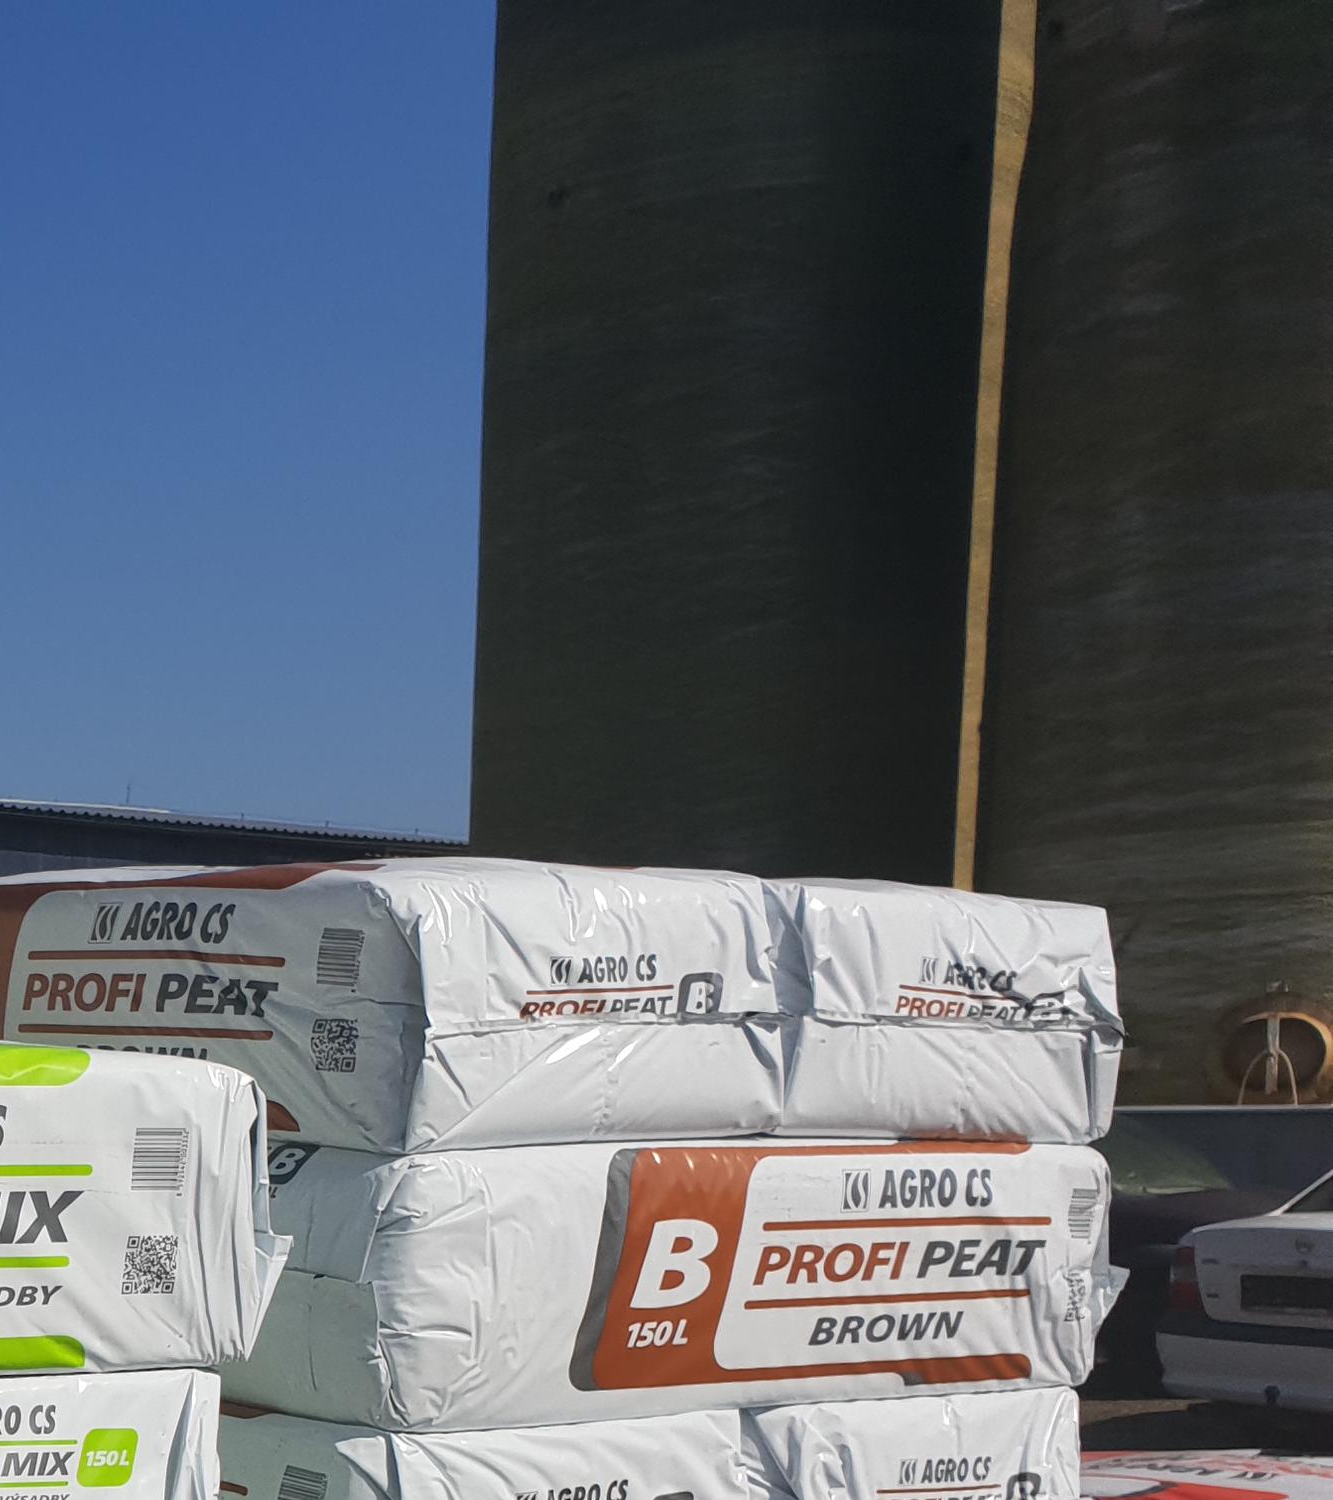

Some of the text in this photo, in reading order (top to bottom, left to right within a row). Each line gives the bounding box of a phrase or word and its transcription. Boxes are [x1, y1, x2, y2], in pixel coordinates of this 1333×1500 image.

[120, 903, 236, 944] AGRO CS
[577, 954, 657, 984] AGRO CS
[22, 974, 279, 1017] PROFI PEAT
[895, 995, 963, 1018] PROFI
[878, 1168, 994, 1209] AGRO CS
[629, 1218, 719, 1310] B
[752, 1239, 1046, 1285] PROFI PEAT
[807, 1310, 963, 1346] BROWN
[28, 1405, 56, 1434] CS
[1, 1451, 74, 1477] MIX
[921, 1456, 991, 1484] AGRO CS
